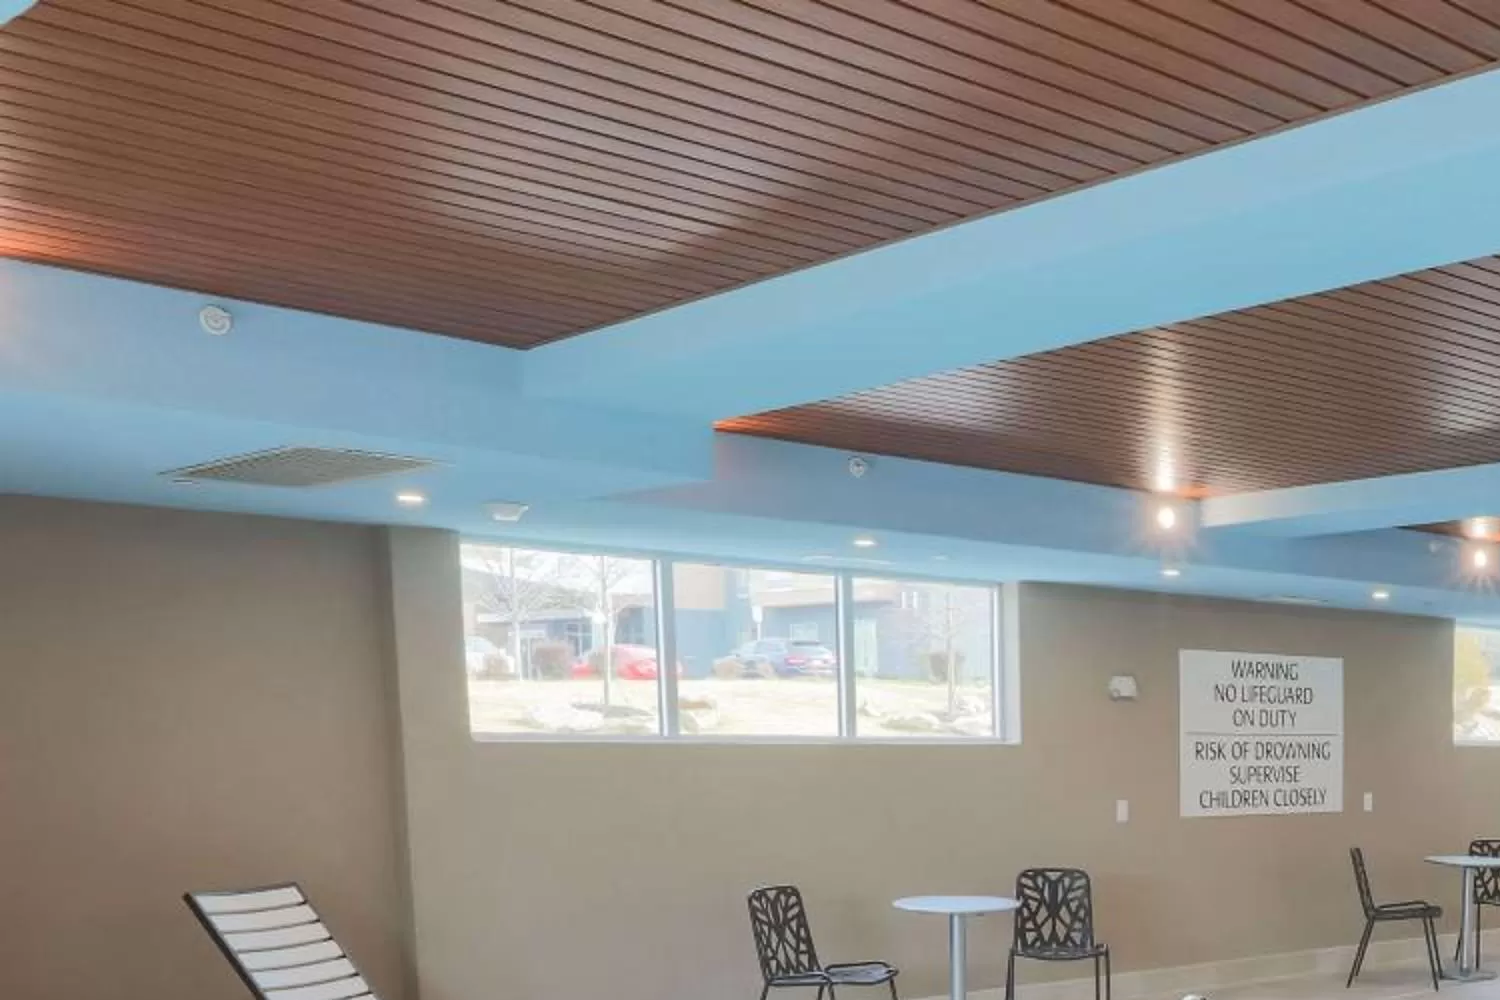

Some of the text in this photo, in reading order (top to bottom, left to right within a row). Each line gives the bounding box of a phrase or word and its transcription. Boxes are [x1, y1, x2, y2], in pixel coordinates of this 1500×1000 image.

[1231, 660, 1299, 681] WARNING
[1214, 684, 1314, 705] NO LIFEGUARD
[1232, 708, 1297, 728] ON DUTY
[1195, 741, 1331, 761] RISK OF DROWNING
[1229, 765, 1301, 784] SUPERVISE
[1199, 788, 1327, 809] CHILDREN CLOSELY
